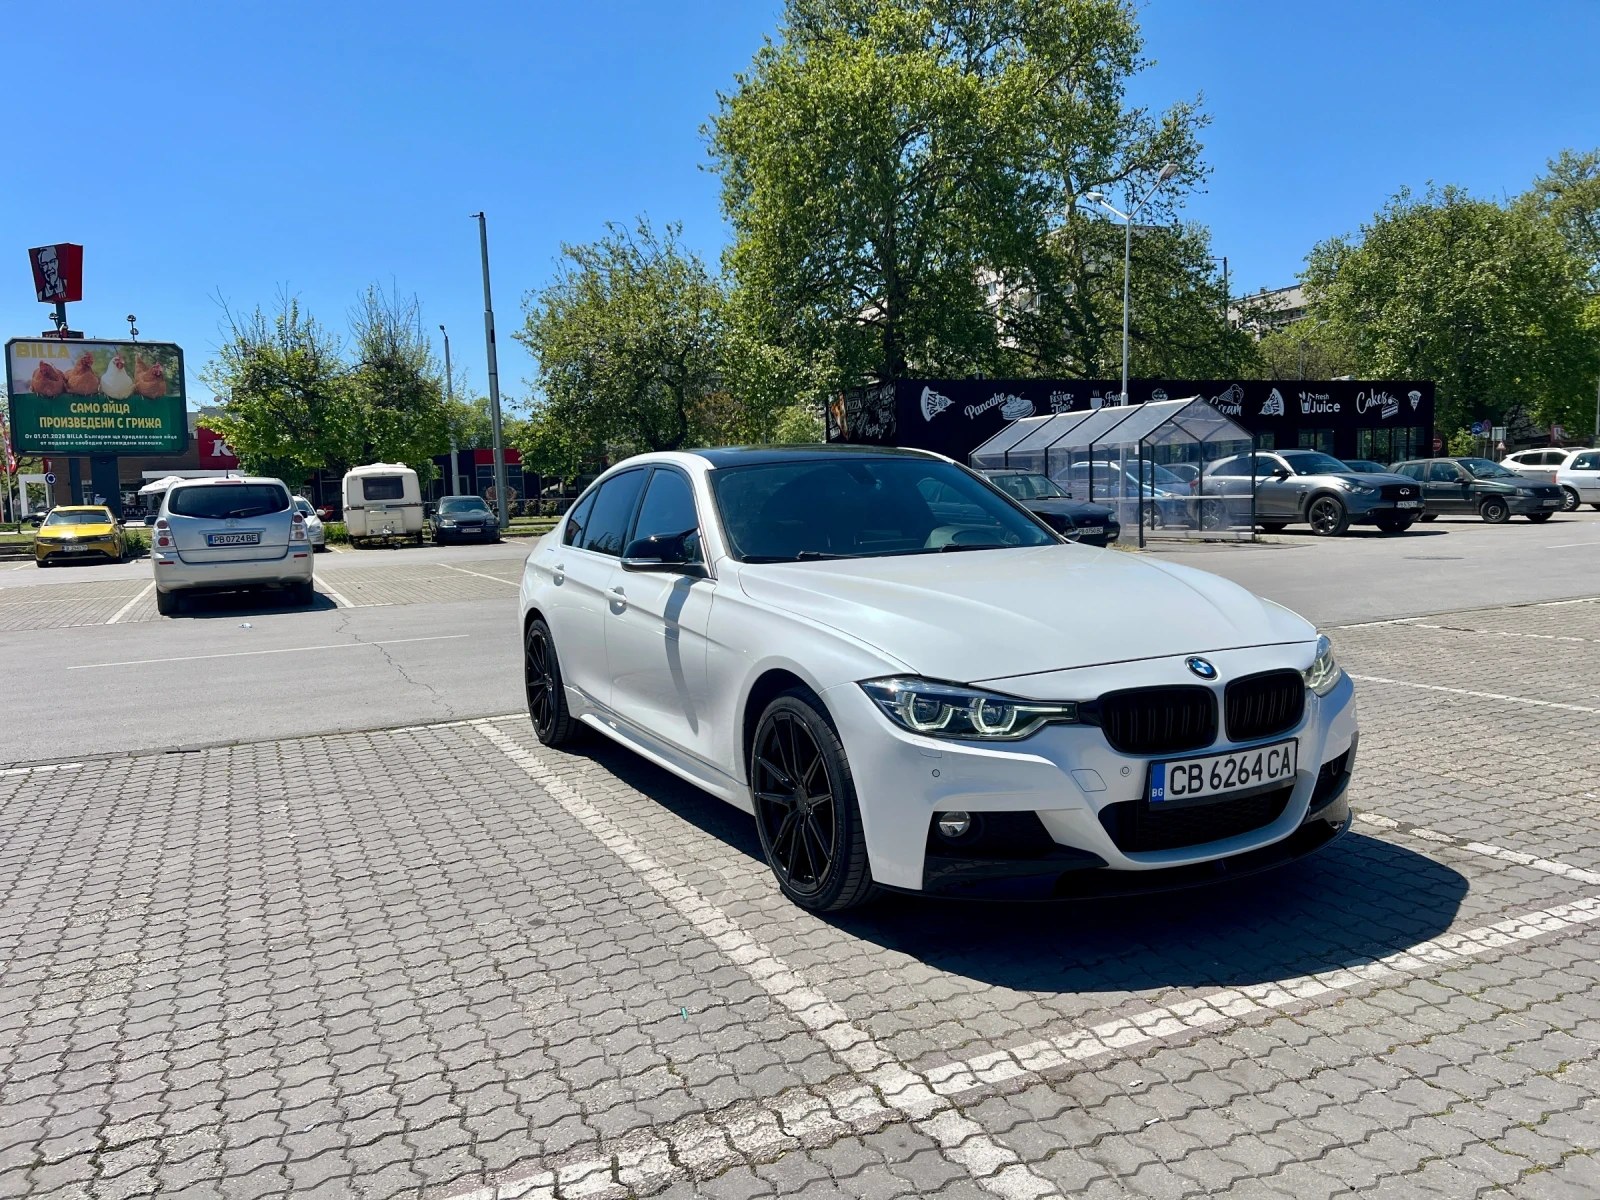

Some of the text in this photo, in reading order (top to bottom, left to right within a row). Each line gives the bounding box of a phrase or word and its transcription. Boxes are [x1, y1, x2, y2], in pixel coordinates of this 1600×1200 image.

[16, 343, 71, 359] BILLA
[70, 401, 130, 415] САМО ЯЙЦА
[964, 392, 1007, 420] Pancake
[1208, 396, 1242, 416] Cream
[1311, 401, 1341, 413] Juice
[1356, 388, 1389, 414] Cakes
[39, 417, 162, 429] ПРОИЗВЕДЕНИ С ГРИЖА
[214, 535, 225, 543] PB
[246, 534, 257, 542] BE
[1169, 746, 1291, 796] CB 6264 CA
[1151, 787, 1163, 798] BG
